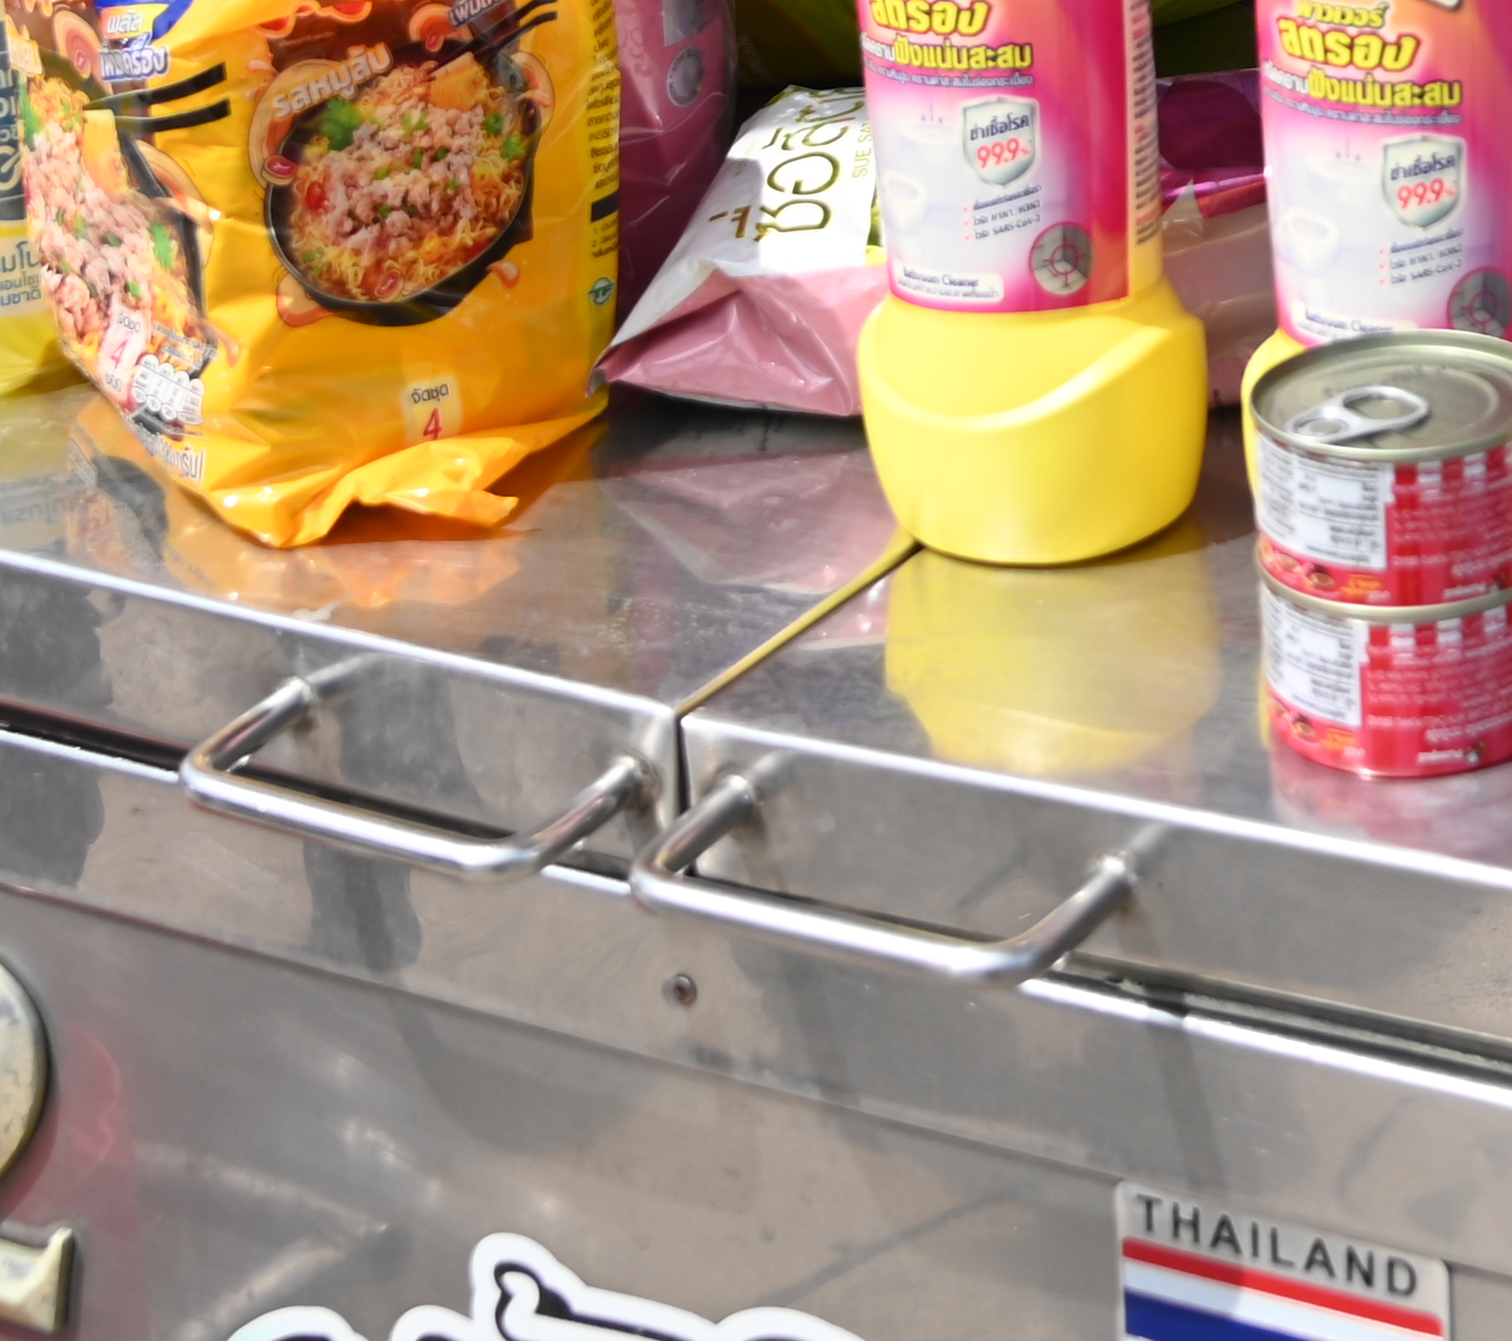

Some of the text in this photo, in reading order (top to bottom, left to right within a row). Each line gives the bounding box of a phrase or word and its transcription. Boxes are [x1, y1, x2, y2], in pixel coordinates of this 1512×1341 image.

[1297, 0, 1388, 28] พาวเวอร์
[1277, 16, 1420, 71] สตรอง
[272, 43, 393, 118] รสหมูสับ
[852, 148, 871, 178] SUE
[942, 271, 980, 287] Cleaner
[110, 340, 129, 369] 4
[411, 383, 449, 403] จัดชุด
[422, 407, 443, 440] 4
[1133, 1195, 1419, 1301] THAILAND
